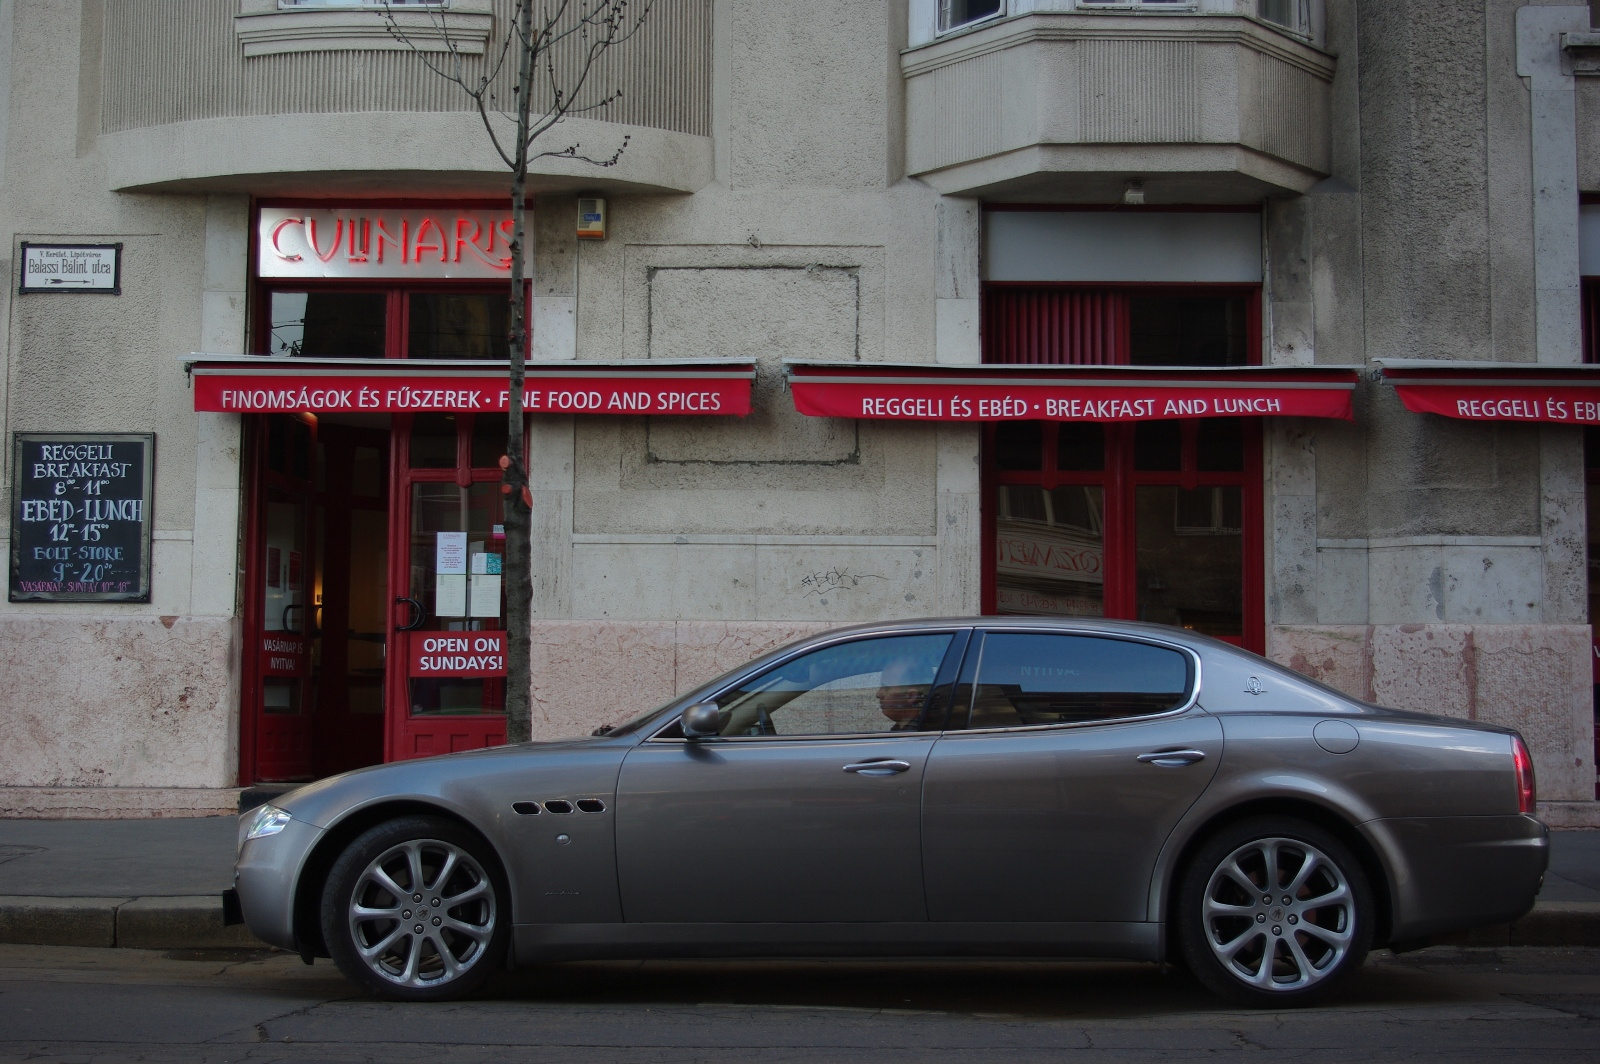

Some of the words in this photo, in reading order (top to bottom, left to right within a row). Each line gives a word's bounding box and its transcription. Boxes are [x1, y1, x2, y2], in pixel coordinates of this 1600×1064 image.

[267, 217, 514, 270] CULINARIS
[28, 259, 59, 274] Balassi
[62, 259, 88, 274] Bálint
[92, 259, 111, 274] utca
[222, 387, 352, 408] FINOMSÁGOK
[358, 386, 380, 408] ÉS
[387, 387, 482, 408] FŰSZEREK
[499, 391, 541, 408] FNE
[548, 391, 602, 409] FOOD
[608, 392, 651, 410] AND
[658, 393, 721, 411] SPICES
[862, 398, 943, 417] REGGELI
[950, 396, 972, 417] ÉS
[979, 396, 1027, 417] EBÉD
[1046, 398, 1155, 418] BREAKFAST
[1163, 400, 1207, 415] AND
[1213, 398, 1281, 413] LUNCH
[1456, 400, 1540, 418] REGGELI
[1546, 397, 1568, 419] ÉS
[1573, 401, 1600, 421] EB
[42, 445, 113, 461] REGGELI
[34, 463, 132, 478] BREAKFAST
[423, 638, 469, 652] OPEN
[474, 638, 500, 652] ON
[420, 655, 503, 671] SUNDAYS!
